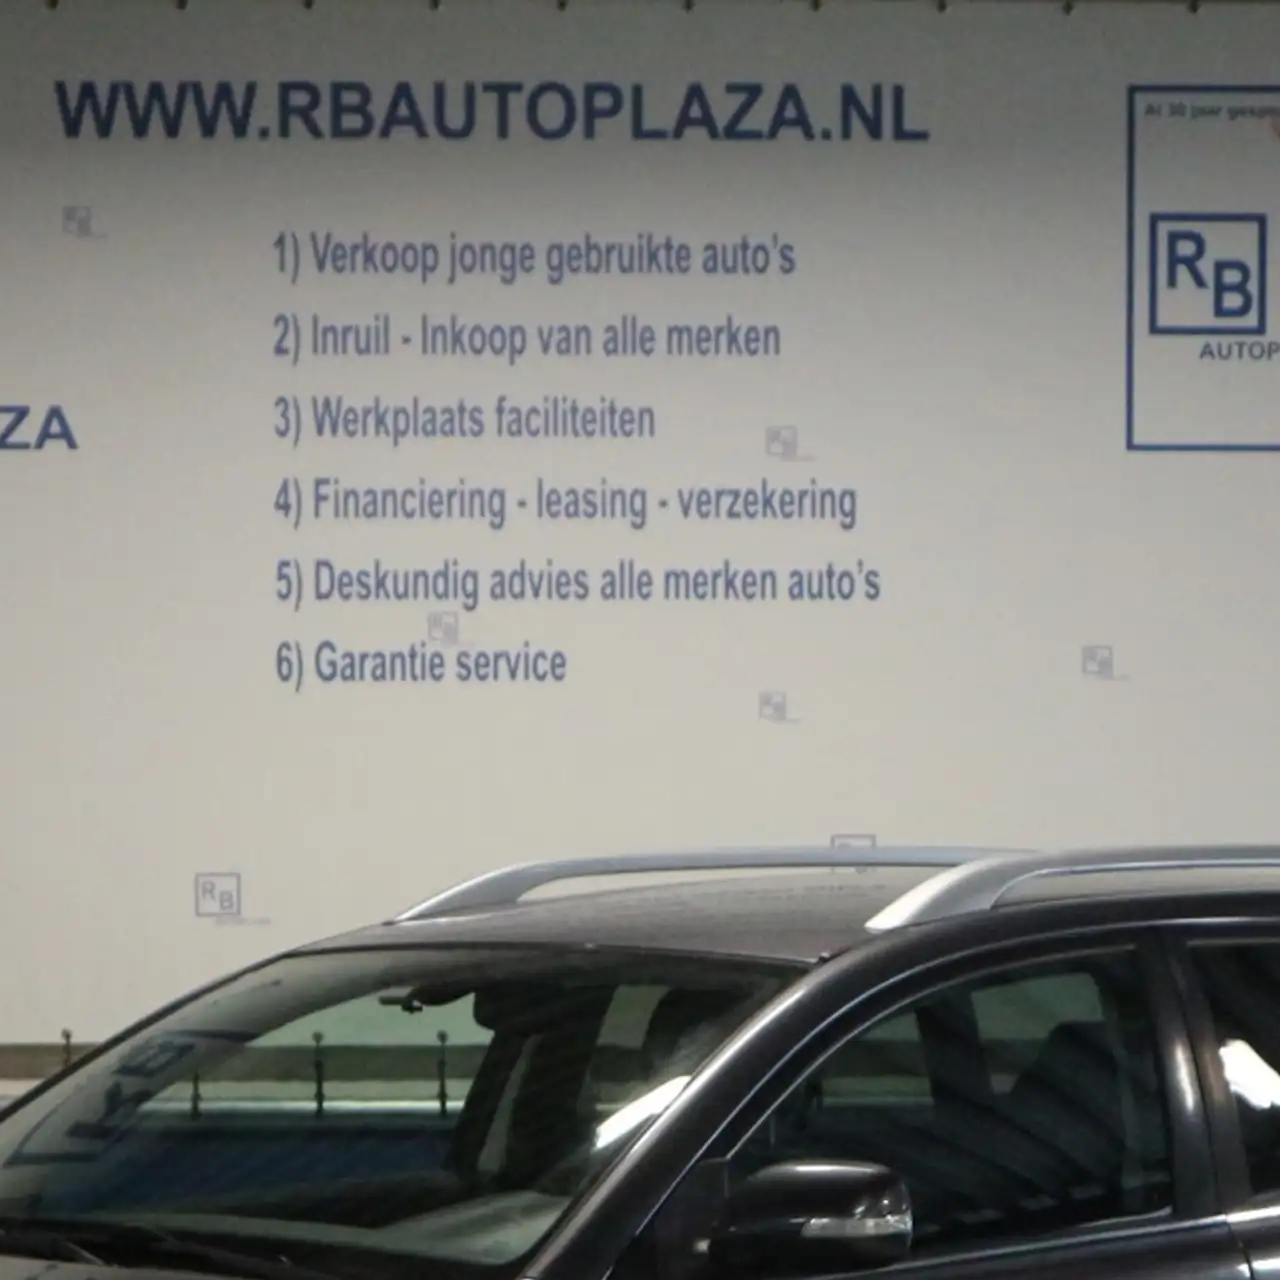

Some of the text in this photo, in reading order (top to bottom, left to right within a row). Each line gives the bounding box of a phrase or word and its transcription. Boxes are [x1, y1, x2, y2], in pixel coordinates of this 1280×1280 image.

[55, 80, 931, 142] WWW.RBAUTOPLAZA.NL
[273, 231, 796, 285] 1) Verkoop jonge gebruikte auto's
[1166, 230, 1254, 318] RB
[273, 313, 301, 366] 2)
[312, 313, 390, 356] Inruil
[421, 313, 527, 366] Inkoop
[537, 324, 592, 356] van
[603, 315, 656, 357] alle
[667, 314, 780, 357] merken
[274, 395, 655, 448] 3) Werkplaats faciliteiten
[274, 478, 302, 530] 4)
[314, 477, 506, 531] Financiering
[537, 478, 647, 530] leasing
[678, 477, 856, 531] verzekering
[276, 559, 880, 612] 5) Deskundig advies alle merken auto's
[276, 640, 566, 693] 6) Garantie service
